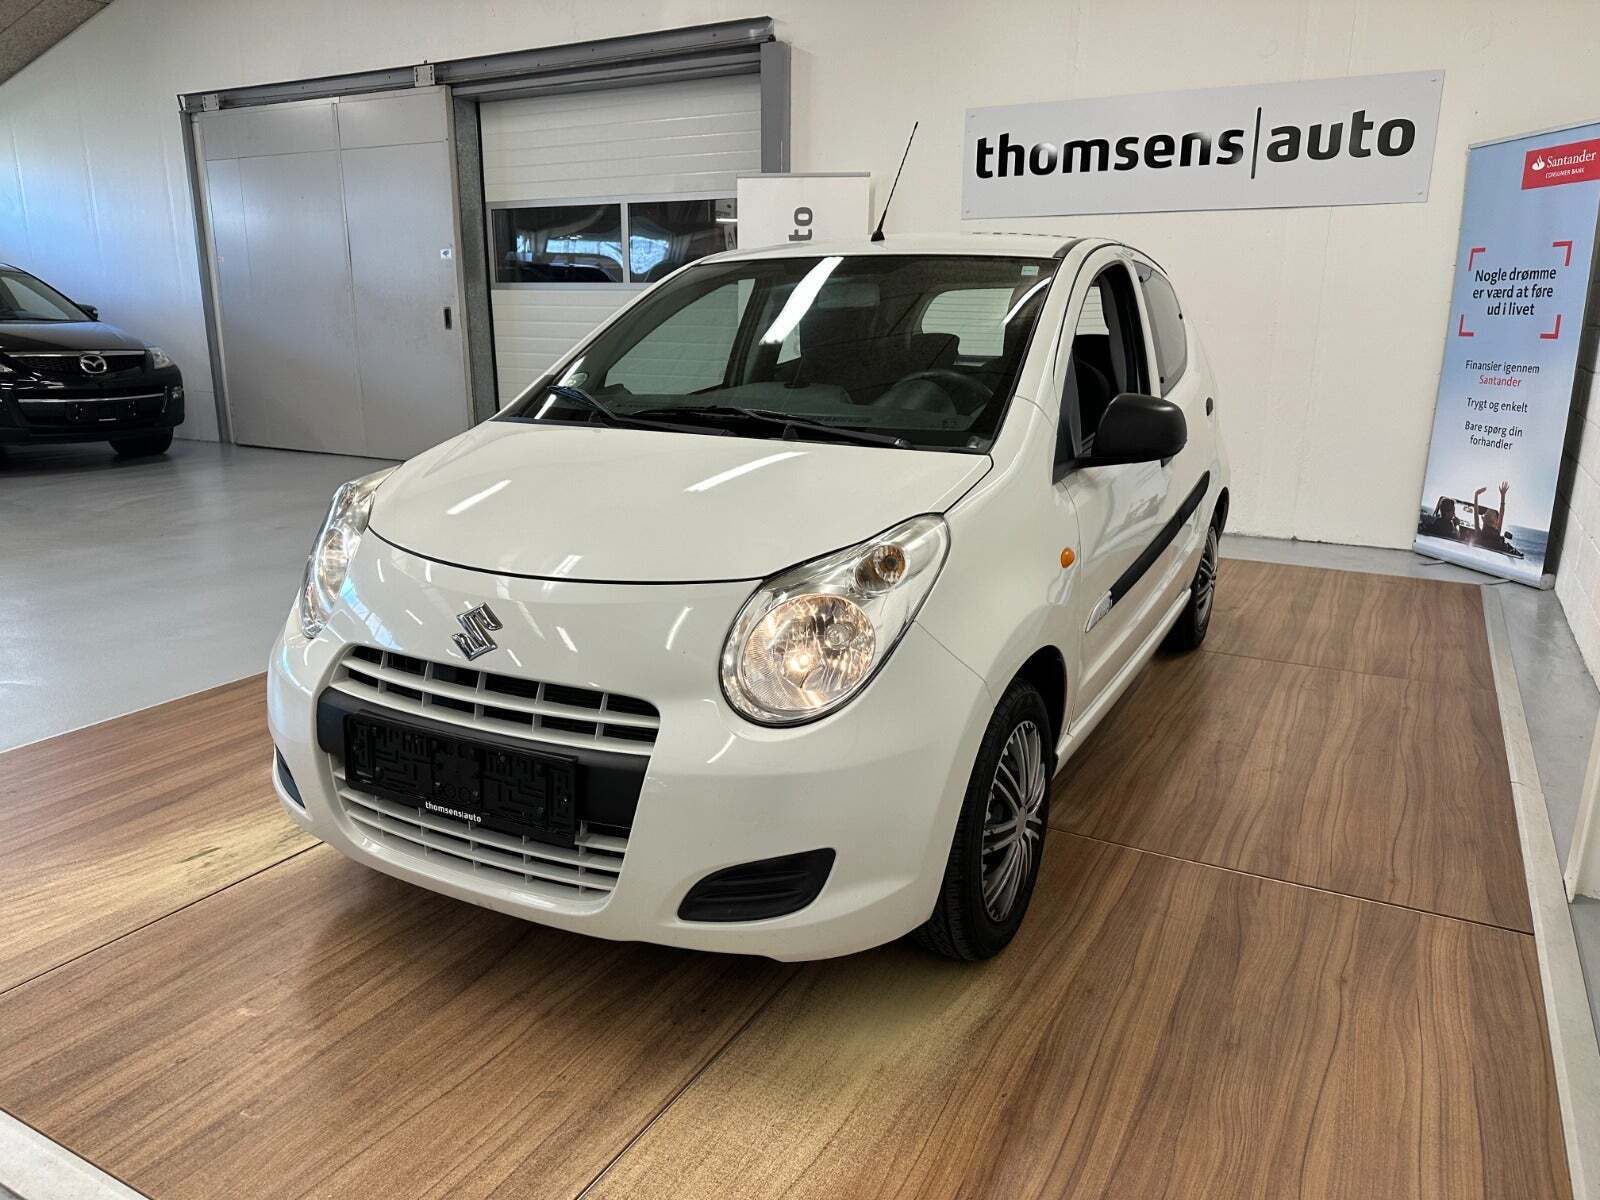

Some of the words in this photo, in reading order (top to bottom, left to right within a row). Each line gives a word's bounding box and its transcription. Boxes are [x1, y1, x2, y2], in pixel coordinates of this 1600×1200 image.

[1546, 149, 1597, 168] Santander
[1475, 267, 1507, 286] Nogle
[1509, 266, 1557, 281] drømme
[1472, 288, 1485, 299] er
[1487, 284, 1514, 299] værd
[1516, 285, 1529, 298] at
[1531, 283, 1554, 298] føre
[1487, 302, 1501, 316] ud
[1502, 302, 1507, 316] i
[1508, 302, 1535, 316] livet
[1465, 359, 1501, 372] Finansier
[1503, 361, 1540, 375] igennem
[1479, 374, 1522, 387] Santander
[1467, 397, 1488, 411] Trygt
[1489, 401, 1500, 413] og
[1501, 401, 1528, 413] enkelt
[1464, 420, 1483, 432] Bare
[1484, 424, 1508, 438] spørg
[1508, 425, 1523, 437] din
[1470, 434, 1512, 451] forhandler
